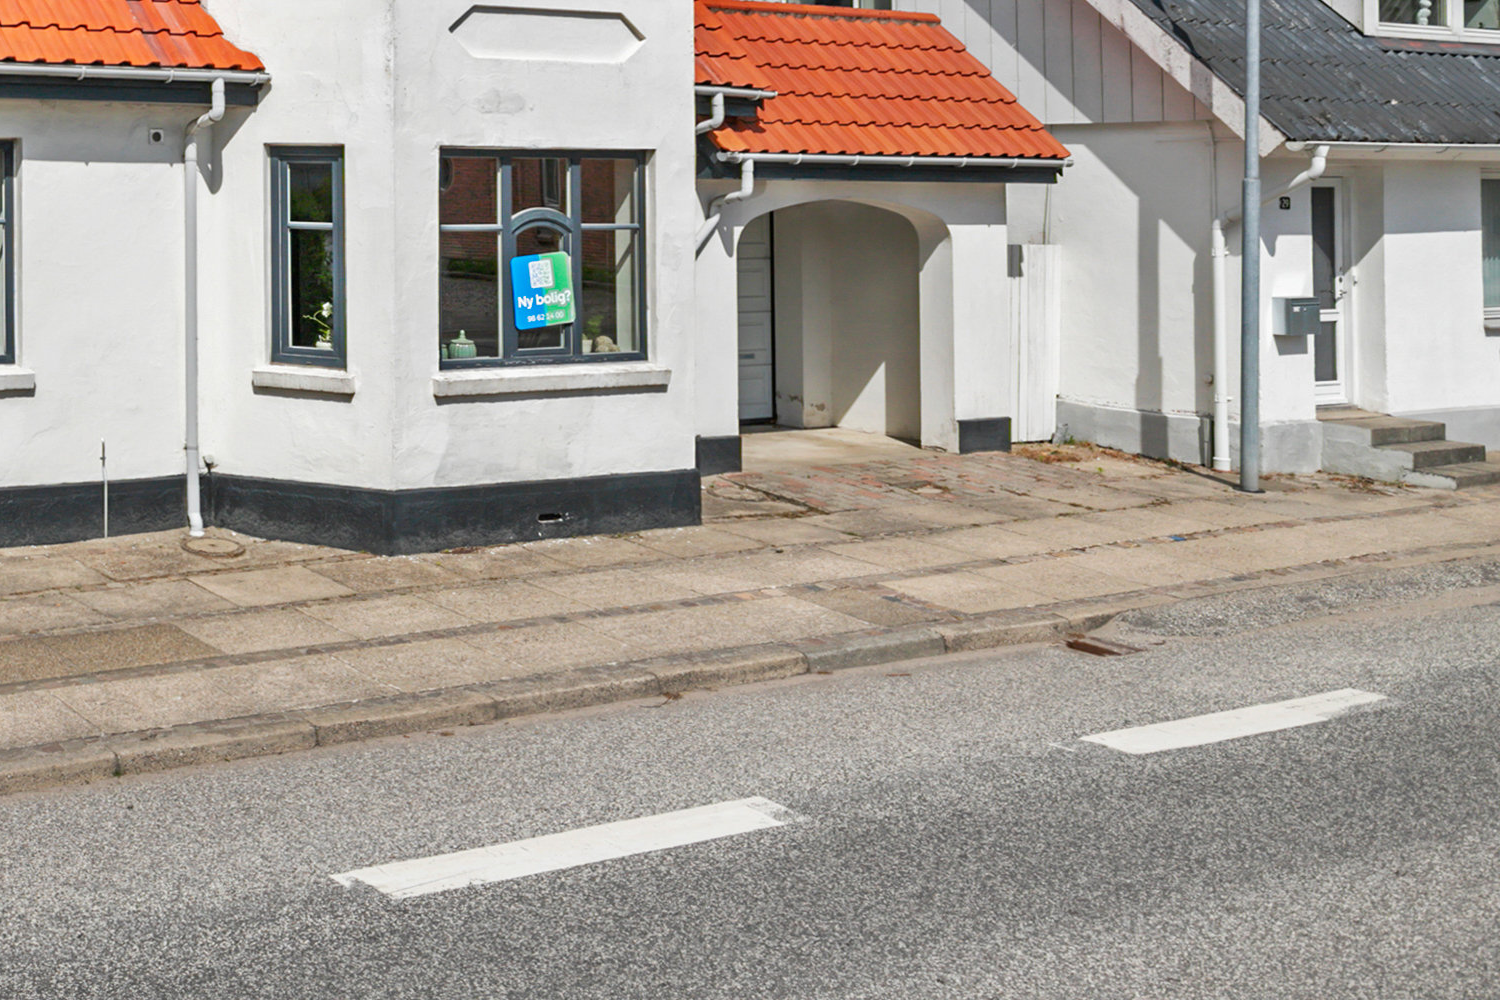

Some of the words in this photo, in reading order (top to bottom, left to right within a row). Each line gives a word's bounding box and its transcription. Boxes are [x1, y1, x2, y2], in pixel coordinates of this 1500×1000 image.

[518, 296, 533, 309] Ny
[536, 290, 571, 305] bolig?
[555, 311, 564, 319] 00
